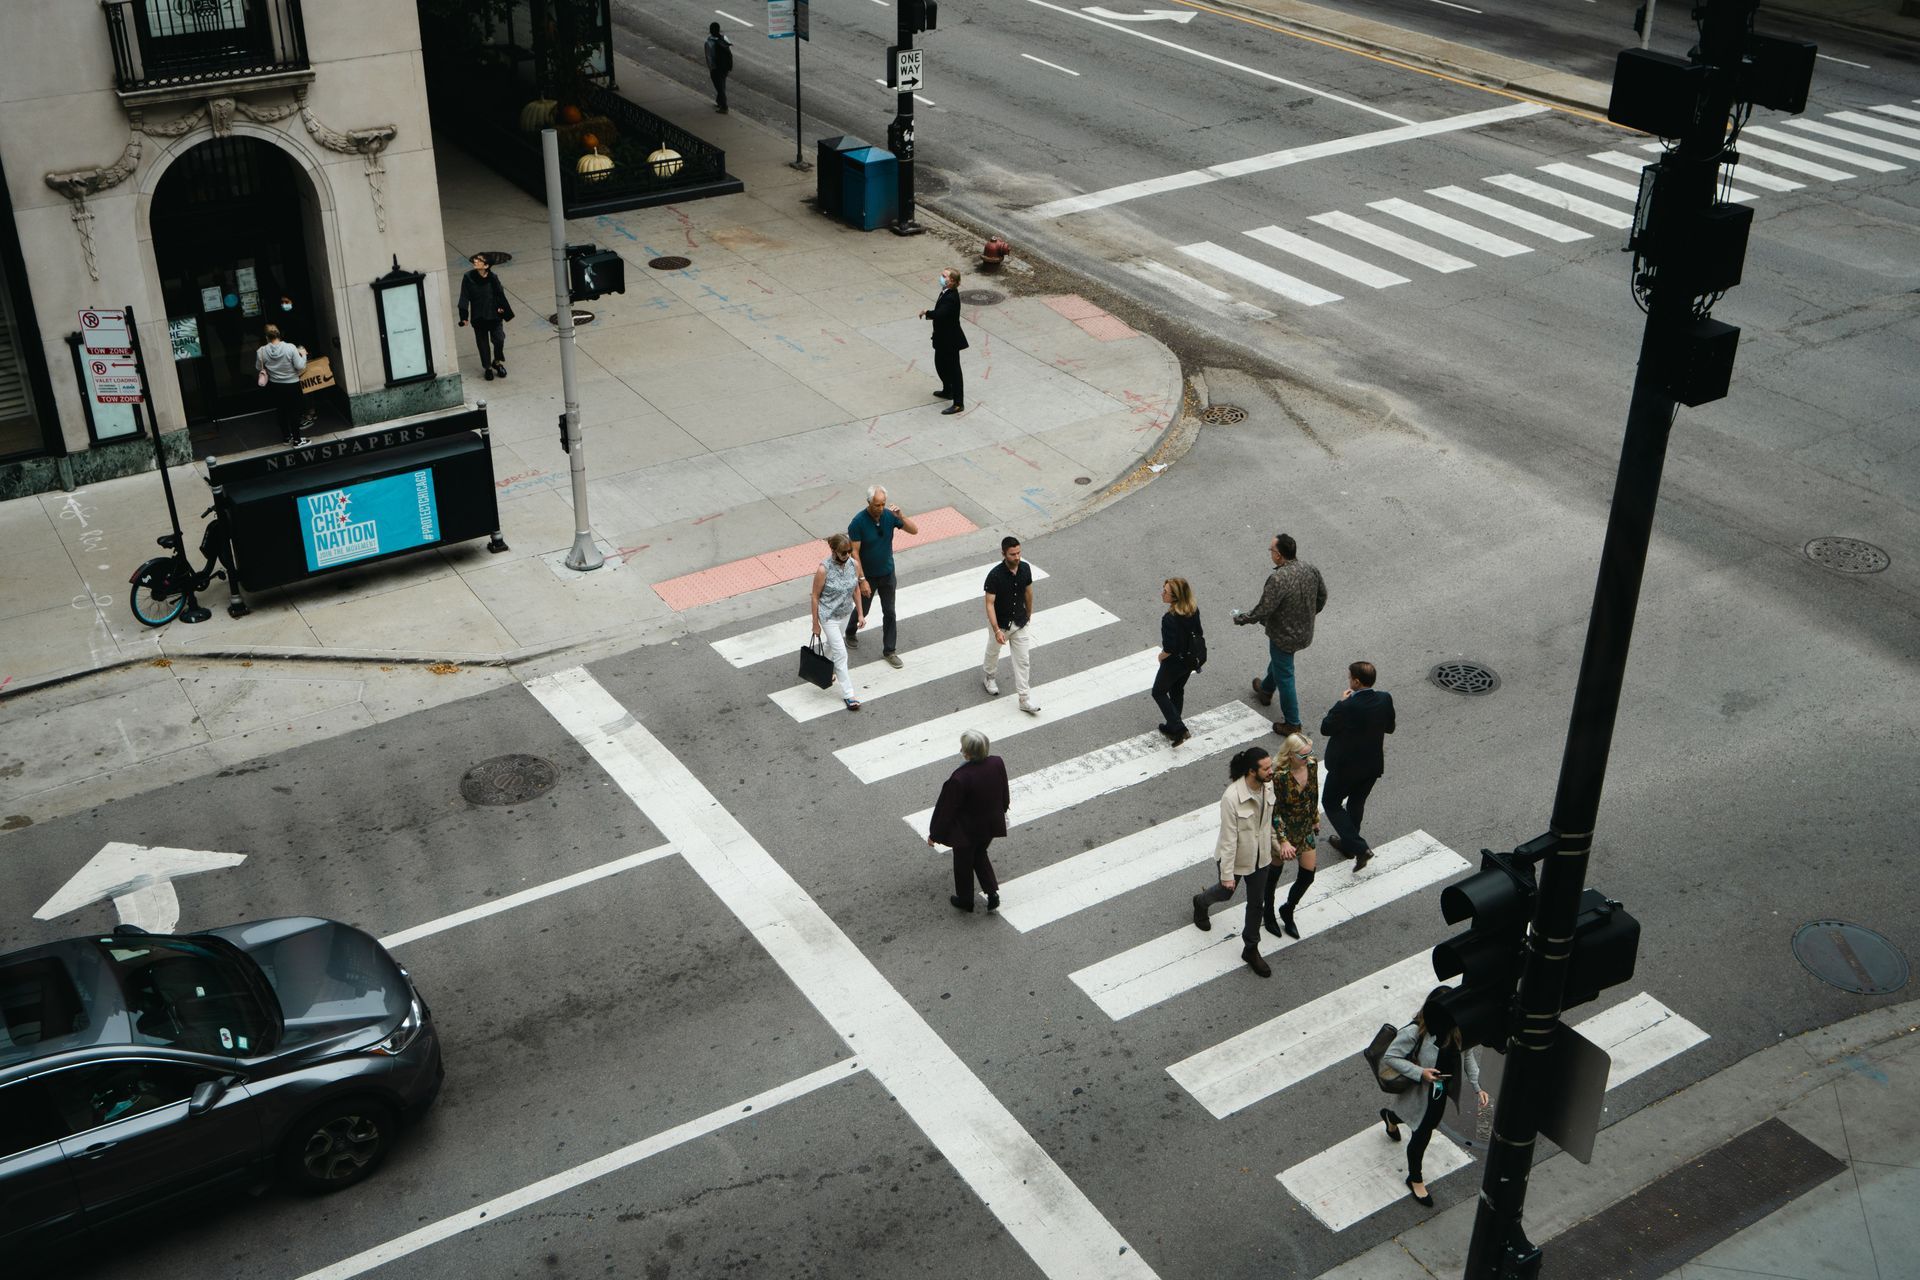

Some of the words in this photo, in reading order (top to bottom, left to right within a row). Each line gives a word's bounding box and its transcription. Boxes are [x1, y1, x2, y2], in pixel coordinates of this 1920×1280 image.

[900, 52, 920, 64] ONE
[900, 64, 920, 76] WAY
[300, 375, 322, 389] NIKE
[266, 427, 425, 471] NEWSPAPERS
[310, 492, 342, 515] VAX
[414, 471, 434, 540] #PROTECTCHICAGO
[316, 522, 375, 551] NATION
[319, 551, 333, 559] JOIN
[333, 548, 344, 556] THE
[345, 540, 376, 552] MOVEMENT
